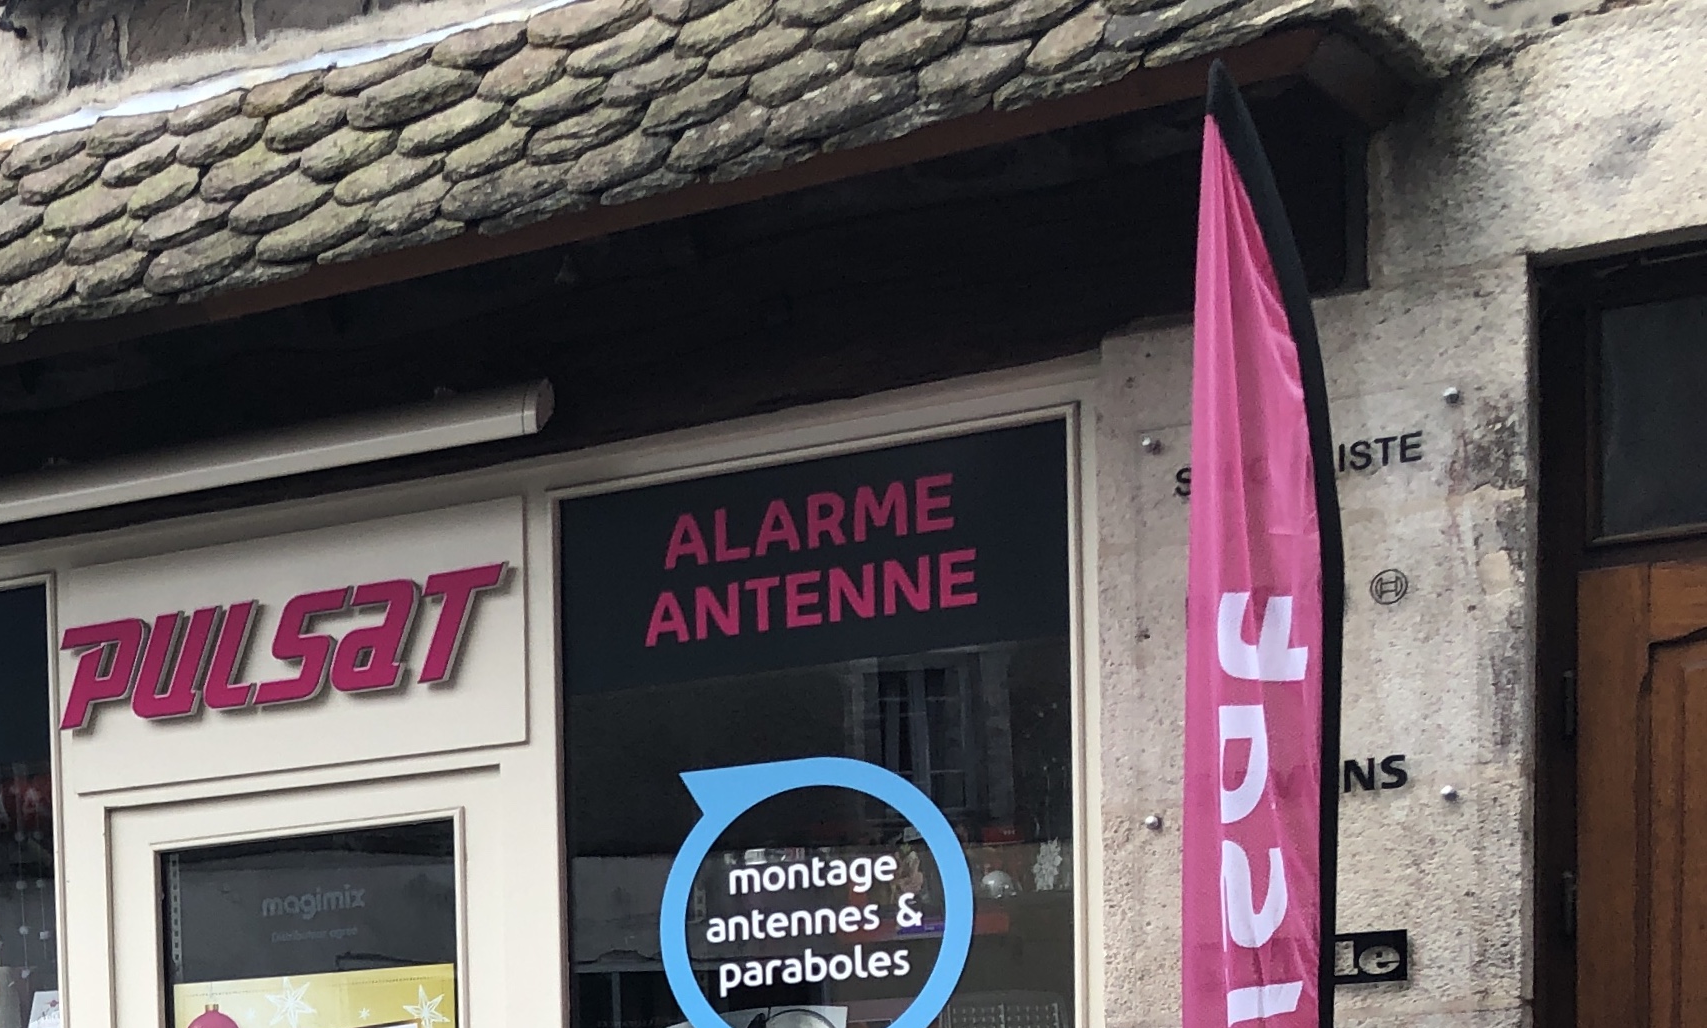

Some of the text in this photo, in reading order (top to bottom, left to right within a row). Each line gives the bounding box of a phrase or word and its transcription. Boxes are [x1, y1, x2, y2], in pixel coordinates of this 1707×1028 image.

[665, 473, 954, 570] ALARME
[645, 548, 978, 648] ANTENNE
[728, 854, 898, 896] montage
[262, 884, 366, 920] magimix
[706, 891, 923, 944] antennes &
[719, 945, 911, 998] paraboles
